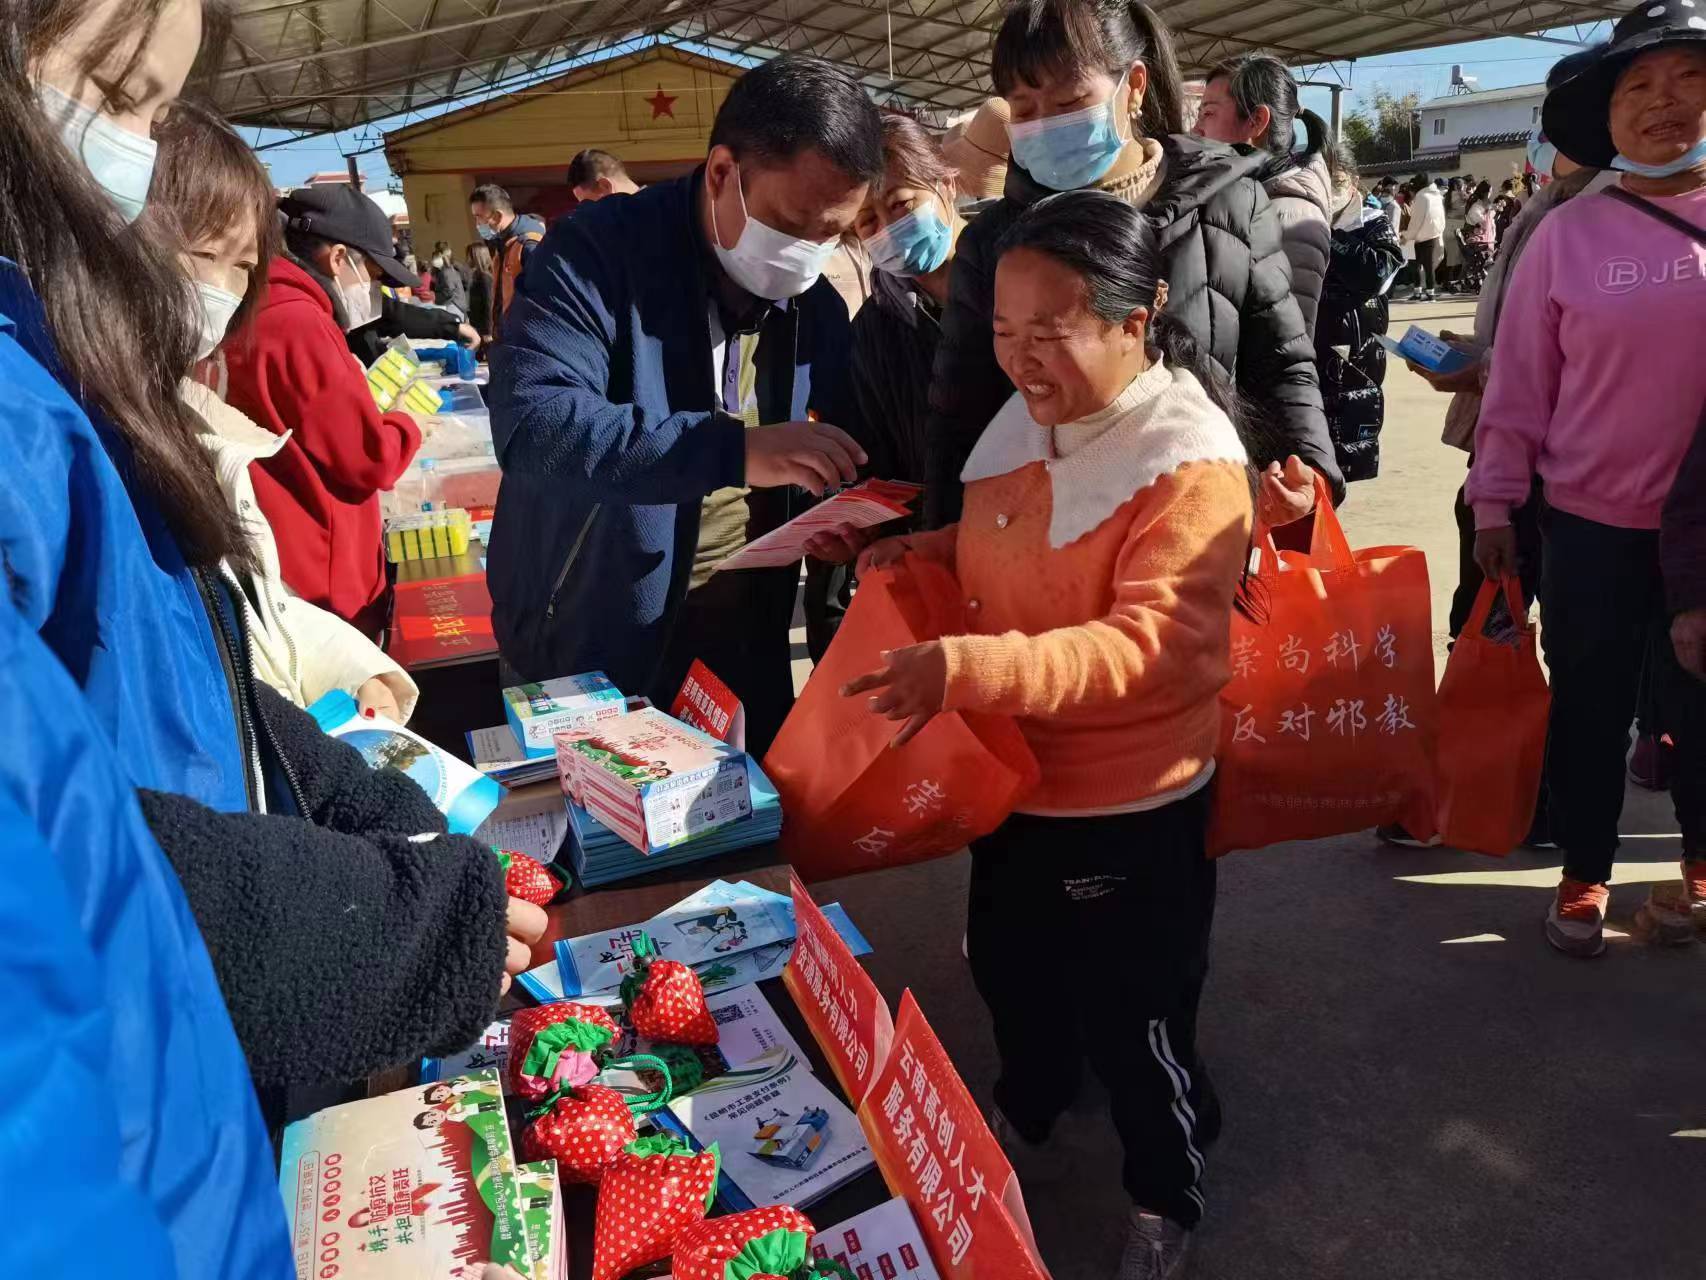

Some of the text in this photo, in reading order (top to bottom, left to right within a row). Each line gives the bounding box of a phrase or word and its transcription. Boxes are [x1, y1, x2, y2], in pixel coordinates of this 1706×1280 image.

[1231, 624, 1397, 679] 崇尚科学
[1232, 694, 1416, 744] 反对邪教
[902, 779, 946, 818] 崇
[899, 1040, 988, 1212] 云南高创人才
[394, 1167, 413, 1245] 共担健康责任
[881, 1078, 974, 1266] 服务有限公司
[367, 1174, 387, 1253] 携手防疫抗艾
